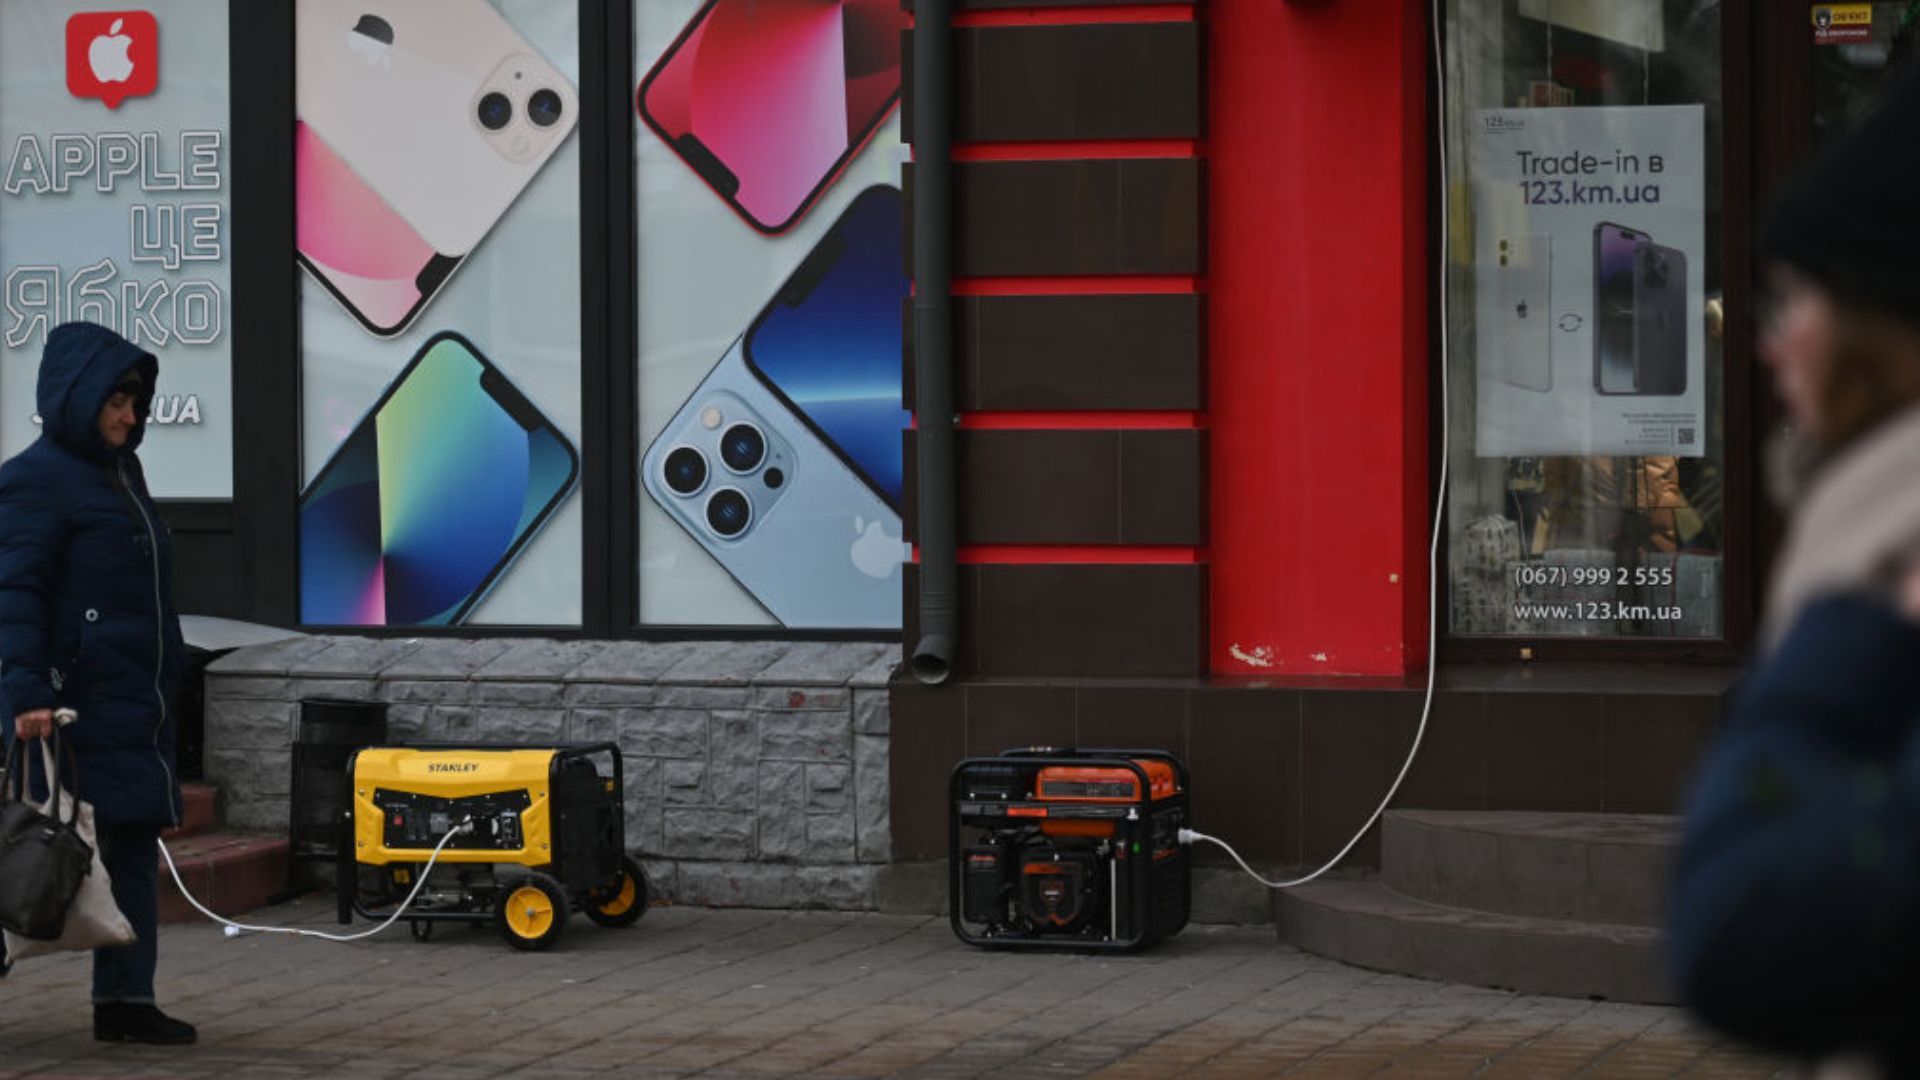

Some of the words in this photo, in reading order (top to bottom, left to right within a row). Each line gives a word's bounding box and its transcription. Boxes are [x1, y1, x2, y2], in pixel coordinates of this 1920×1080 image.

[4, 131, 221, 196] APPLE
[1516, 150, 1639, 175] Trade-in
[1519, 181, 1660, 205] 123.km.ua
[131, 204, 221, 270] ЦЕ
[1515, 567, 1567, 588] (067)
[1573, 567, 1611, 586] 999
[1617, 567, 1629, 586] 2
[1635, 567, 1673, 586] 555
[1514, 602, 1682, 621] www.123.km.ua
[428, 763, 479, 773] STANLEY
